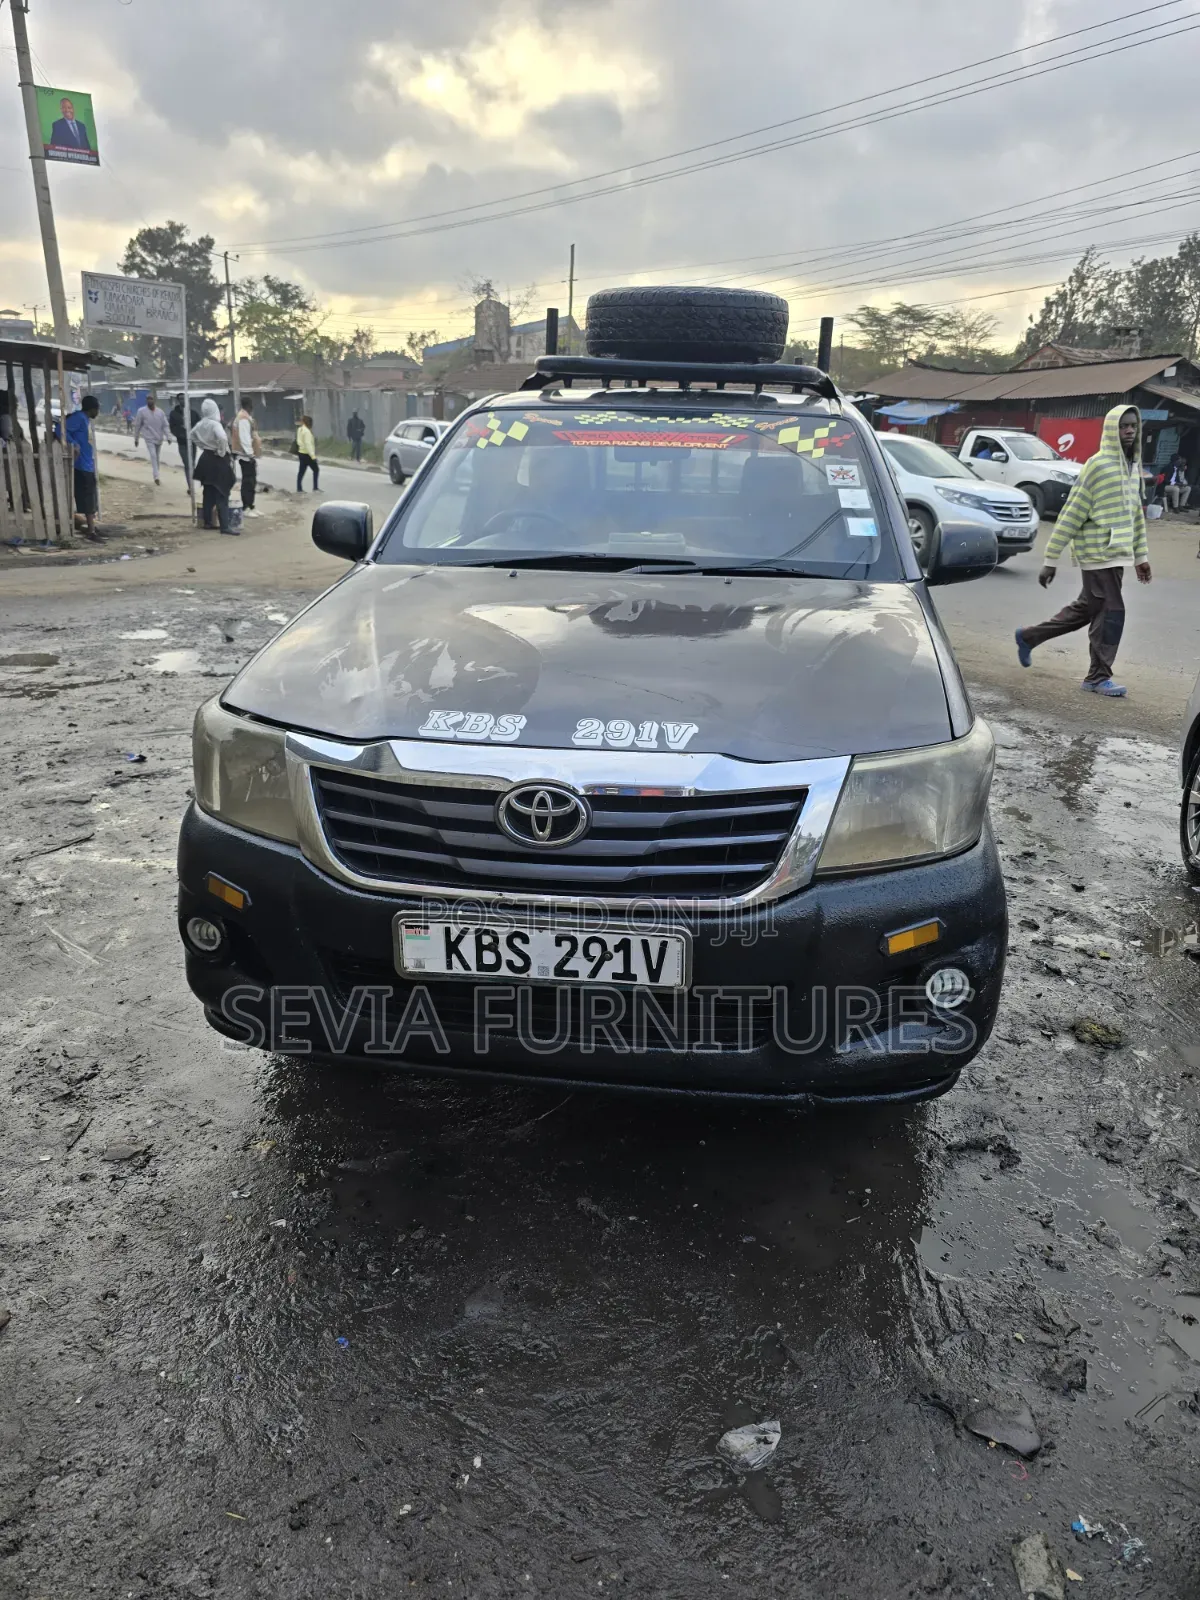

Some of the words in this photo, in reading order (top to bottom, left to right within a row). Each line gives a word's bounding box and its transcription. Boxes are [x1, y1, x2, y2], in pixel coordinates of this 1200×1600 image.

[121, 283, 151, 297] CHURCHES
[105, 311, 136, 325] 300M
[146, 308, 179, 322] BRANCH
[652, 440, 730, 449] DEVELOPMENT
[418, 709, 528, 742] KBS
[571, 717, 699, 750] 291V
[443, 926, 533, 977] KBS
[553, 935, 670, 984] 291V
